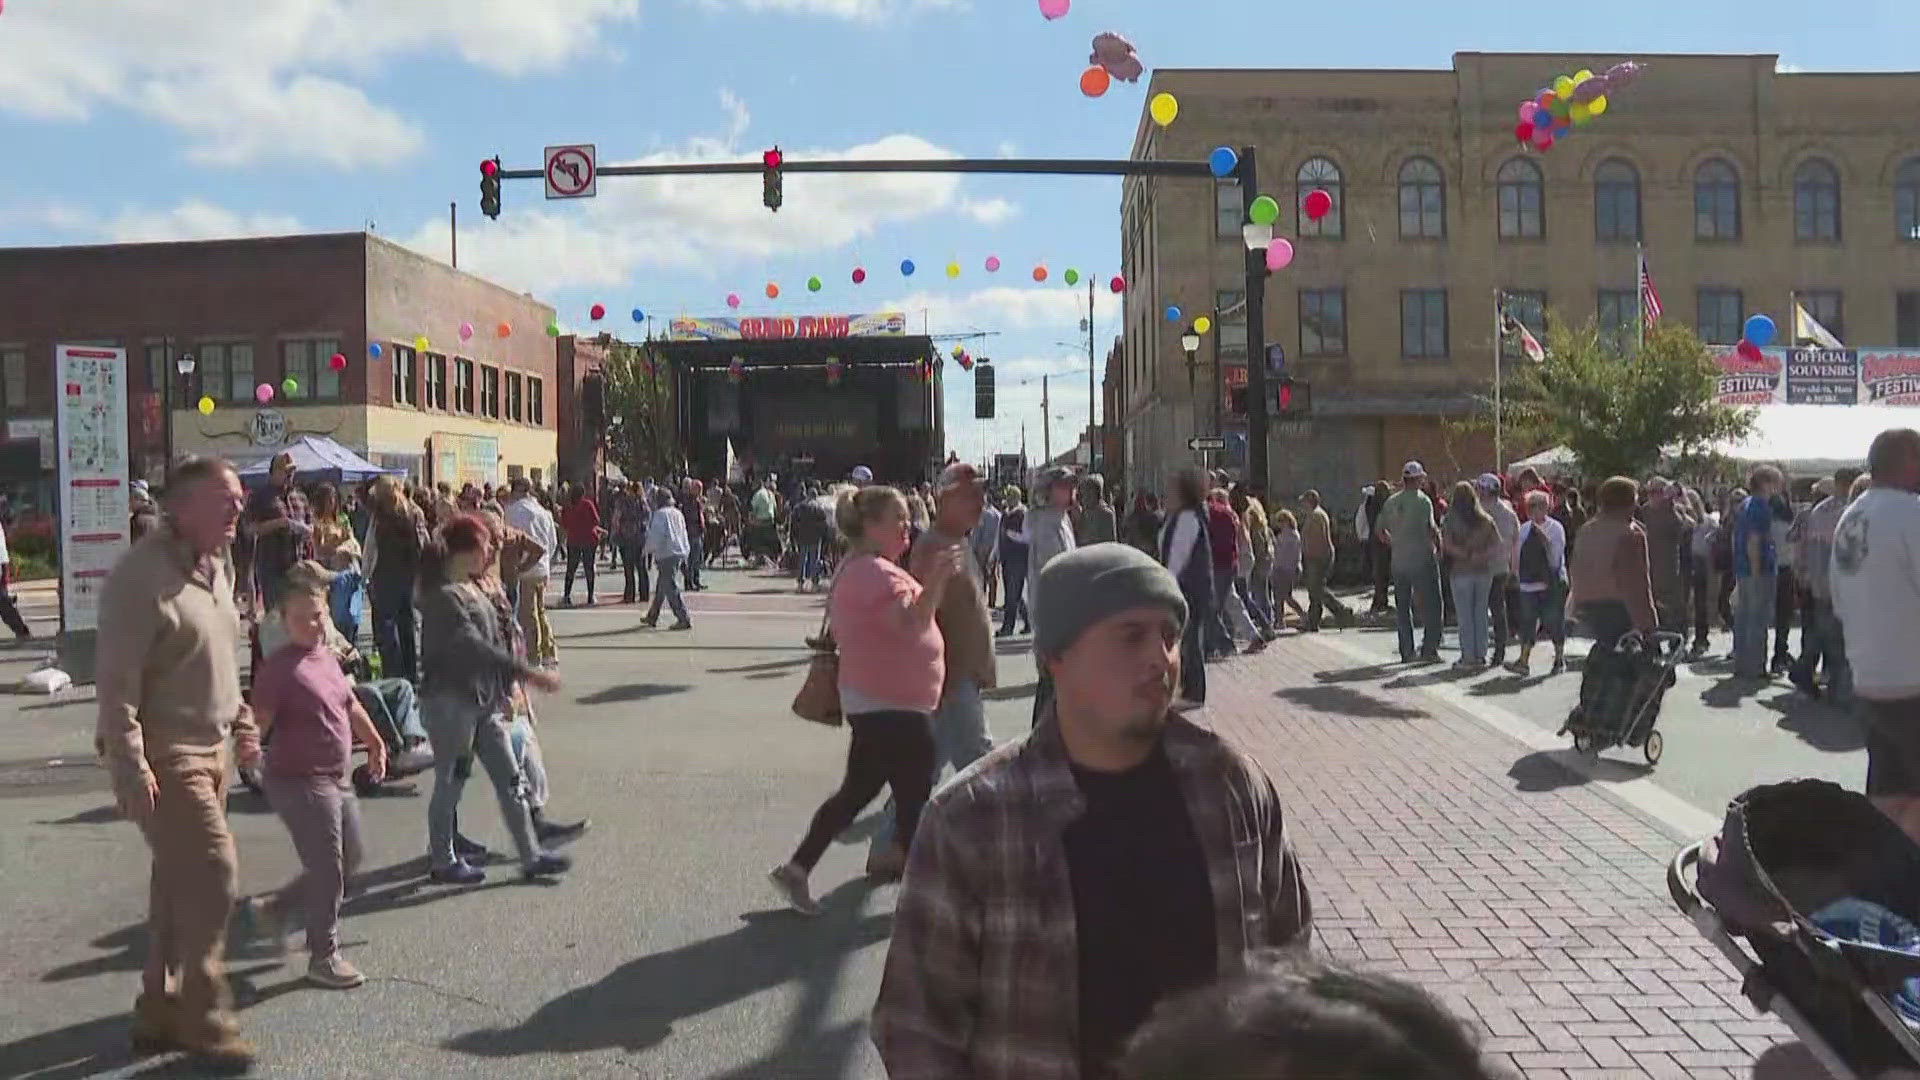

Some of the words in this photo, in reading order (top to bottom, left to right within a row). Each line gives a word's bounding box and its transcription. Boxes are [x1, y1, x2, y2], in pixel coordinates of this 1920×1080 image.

[740, 318, 795, 338] GRAND
[799, 316, 849, 337] STAND
[1794, 351, 1849, 363] OFFICIAL
[1788, 364, 1855, 376] SOUVENIRS
[1717, 377, 1772, 393] ESTIVAL
